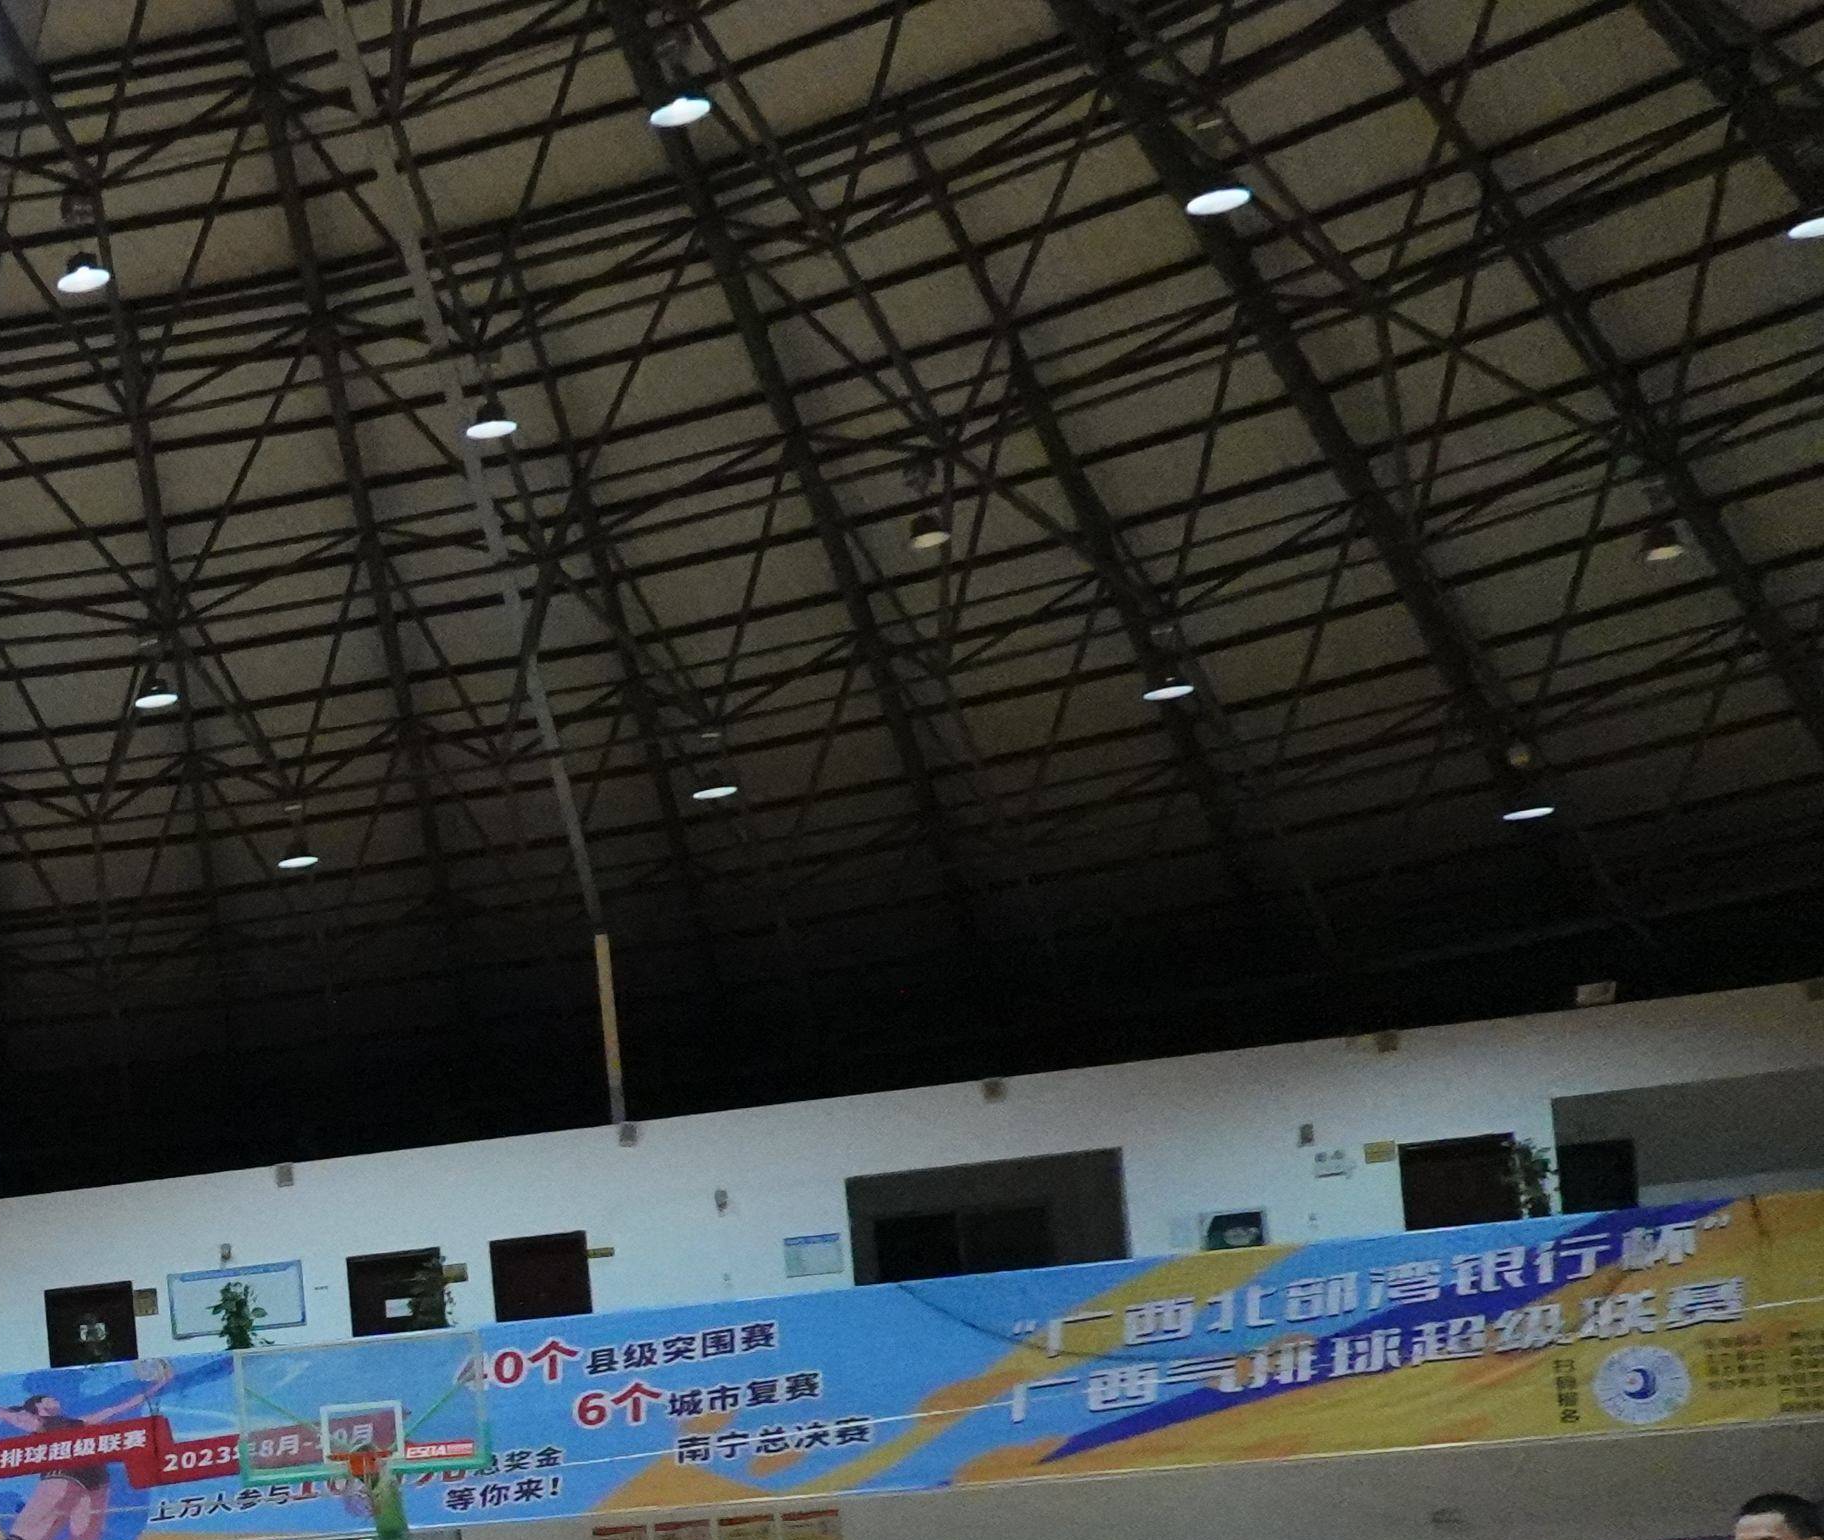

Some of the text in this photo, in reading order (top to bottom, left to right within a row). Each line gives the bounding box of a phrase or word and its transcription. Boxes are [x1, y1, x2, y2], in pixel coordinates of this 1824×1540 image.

[1010, 1276, 1746, 1422] 广西气排球超级联赛
[575, 1369, 823, 1429] 6个城市复赛
[676, 1416, 873, 1463] 南宁总决赛
